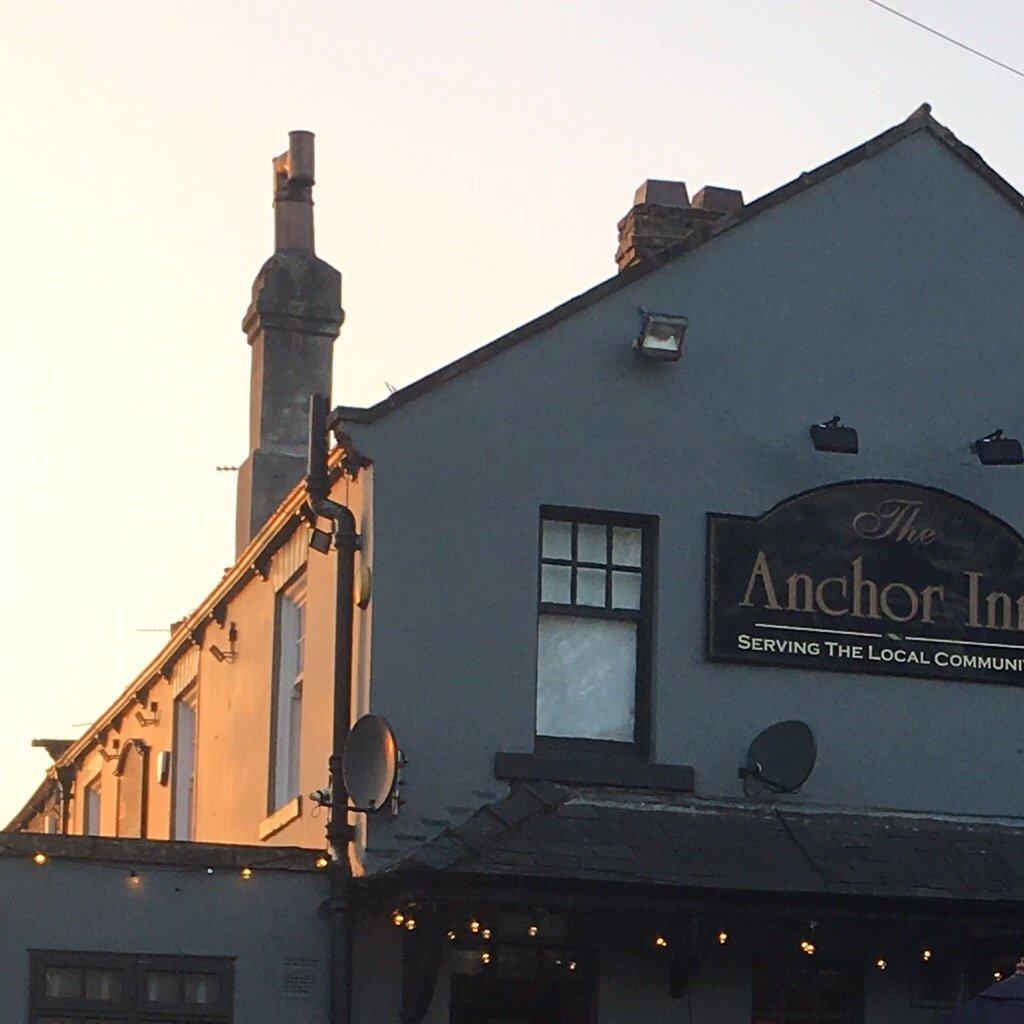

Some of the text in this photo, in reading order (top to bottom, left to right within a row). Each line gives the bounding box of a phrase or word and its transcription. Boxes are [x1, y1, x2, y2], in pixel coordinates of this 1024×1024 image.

[853, 499, 936, 545] The
[738, 551, 945, 623] Anchor
[738, 634, 820, 655] SERVING
[825, 641, 864, 659] THE
[868, 645, 930, 664] LOCAL
